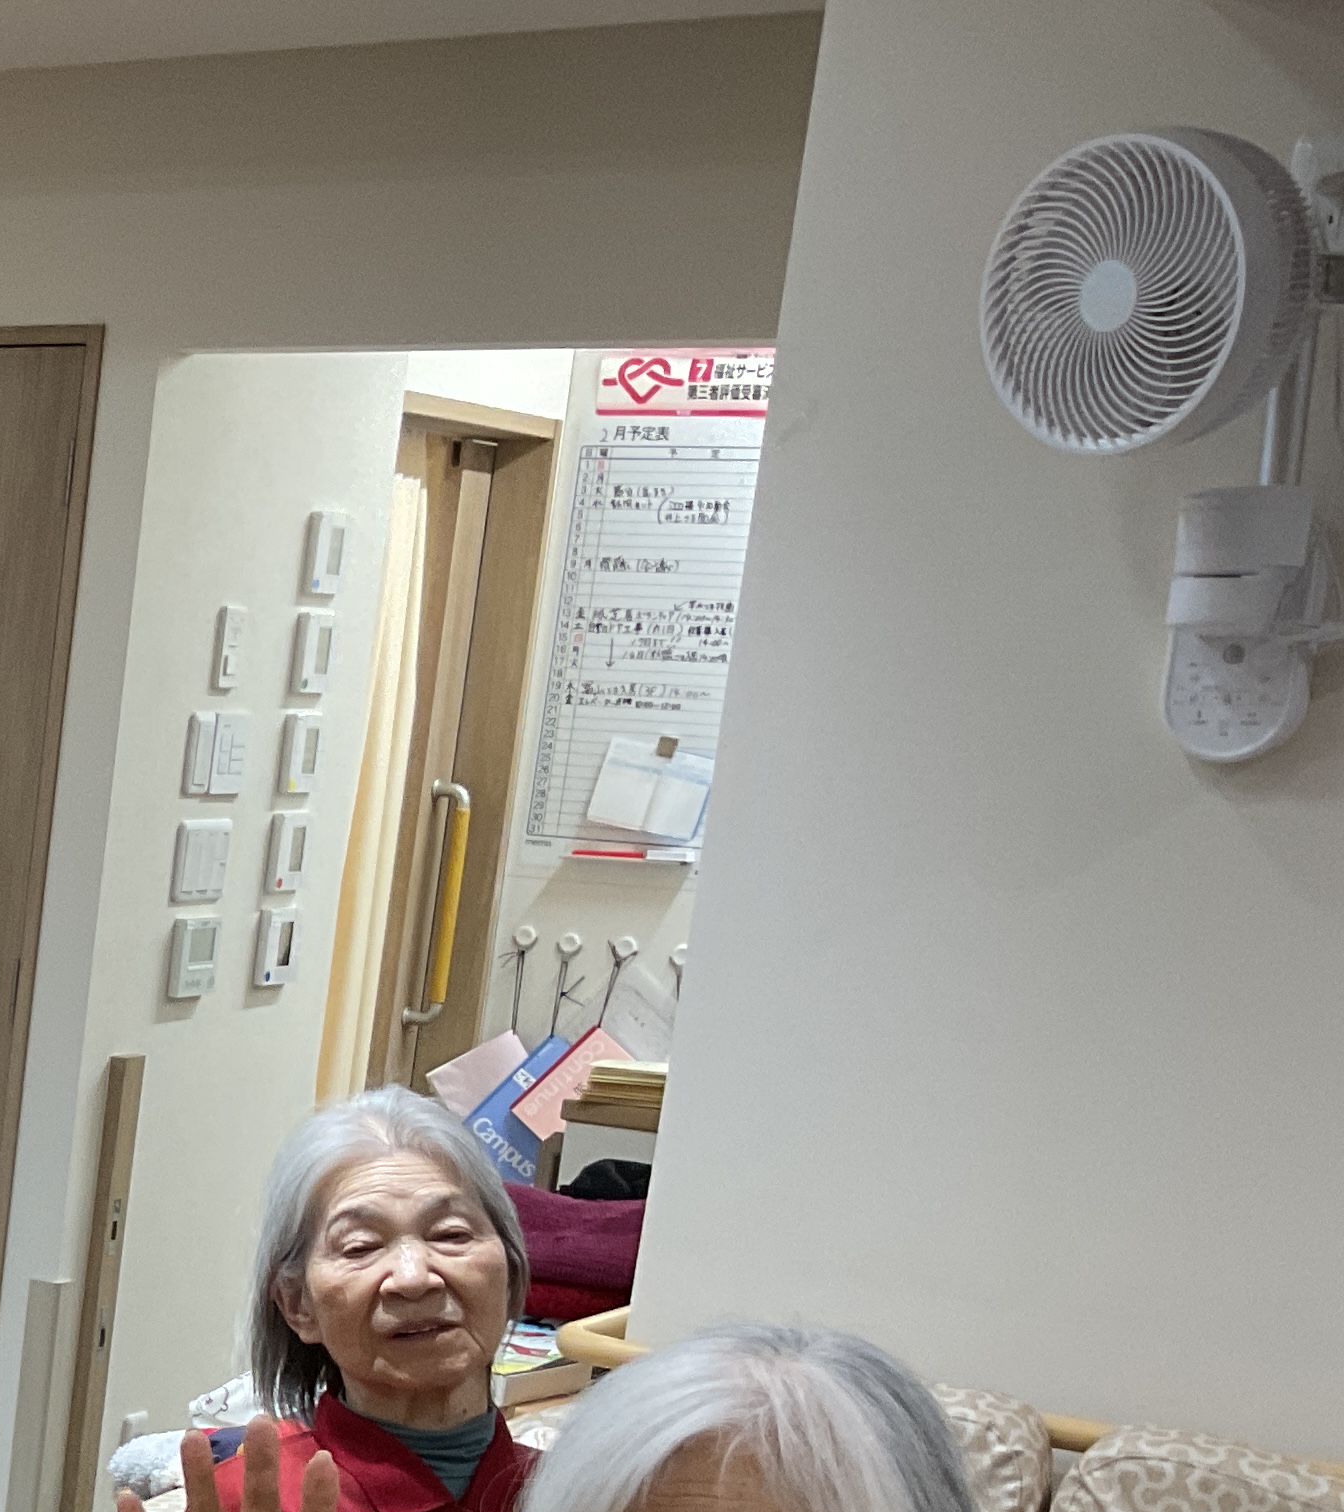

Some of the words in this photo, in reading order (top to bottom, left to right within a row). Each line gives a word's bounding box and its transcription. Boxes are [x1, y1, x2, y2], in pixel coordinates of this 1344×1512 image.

[613, 425, 670, 442] 月予定表
[541, 741, 553, 750] 24
[472, 1116, 537, 1179] Campus
